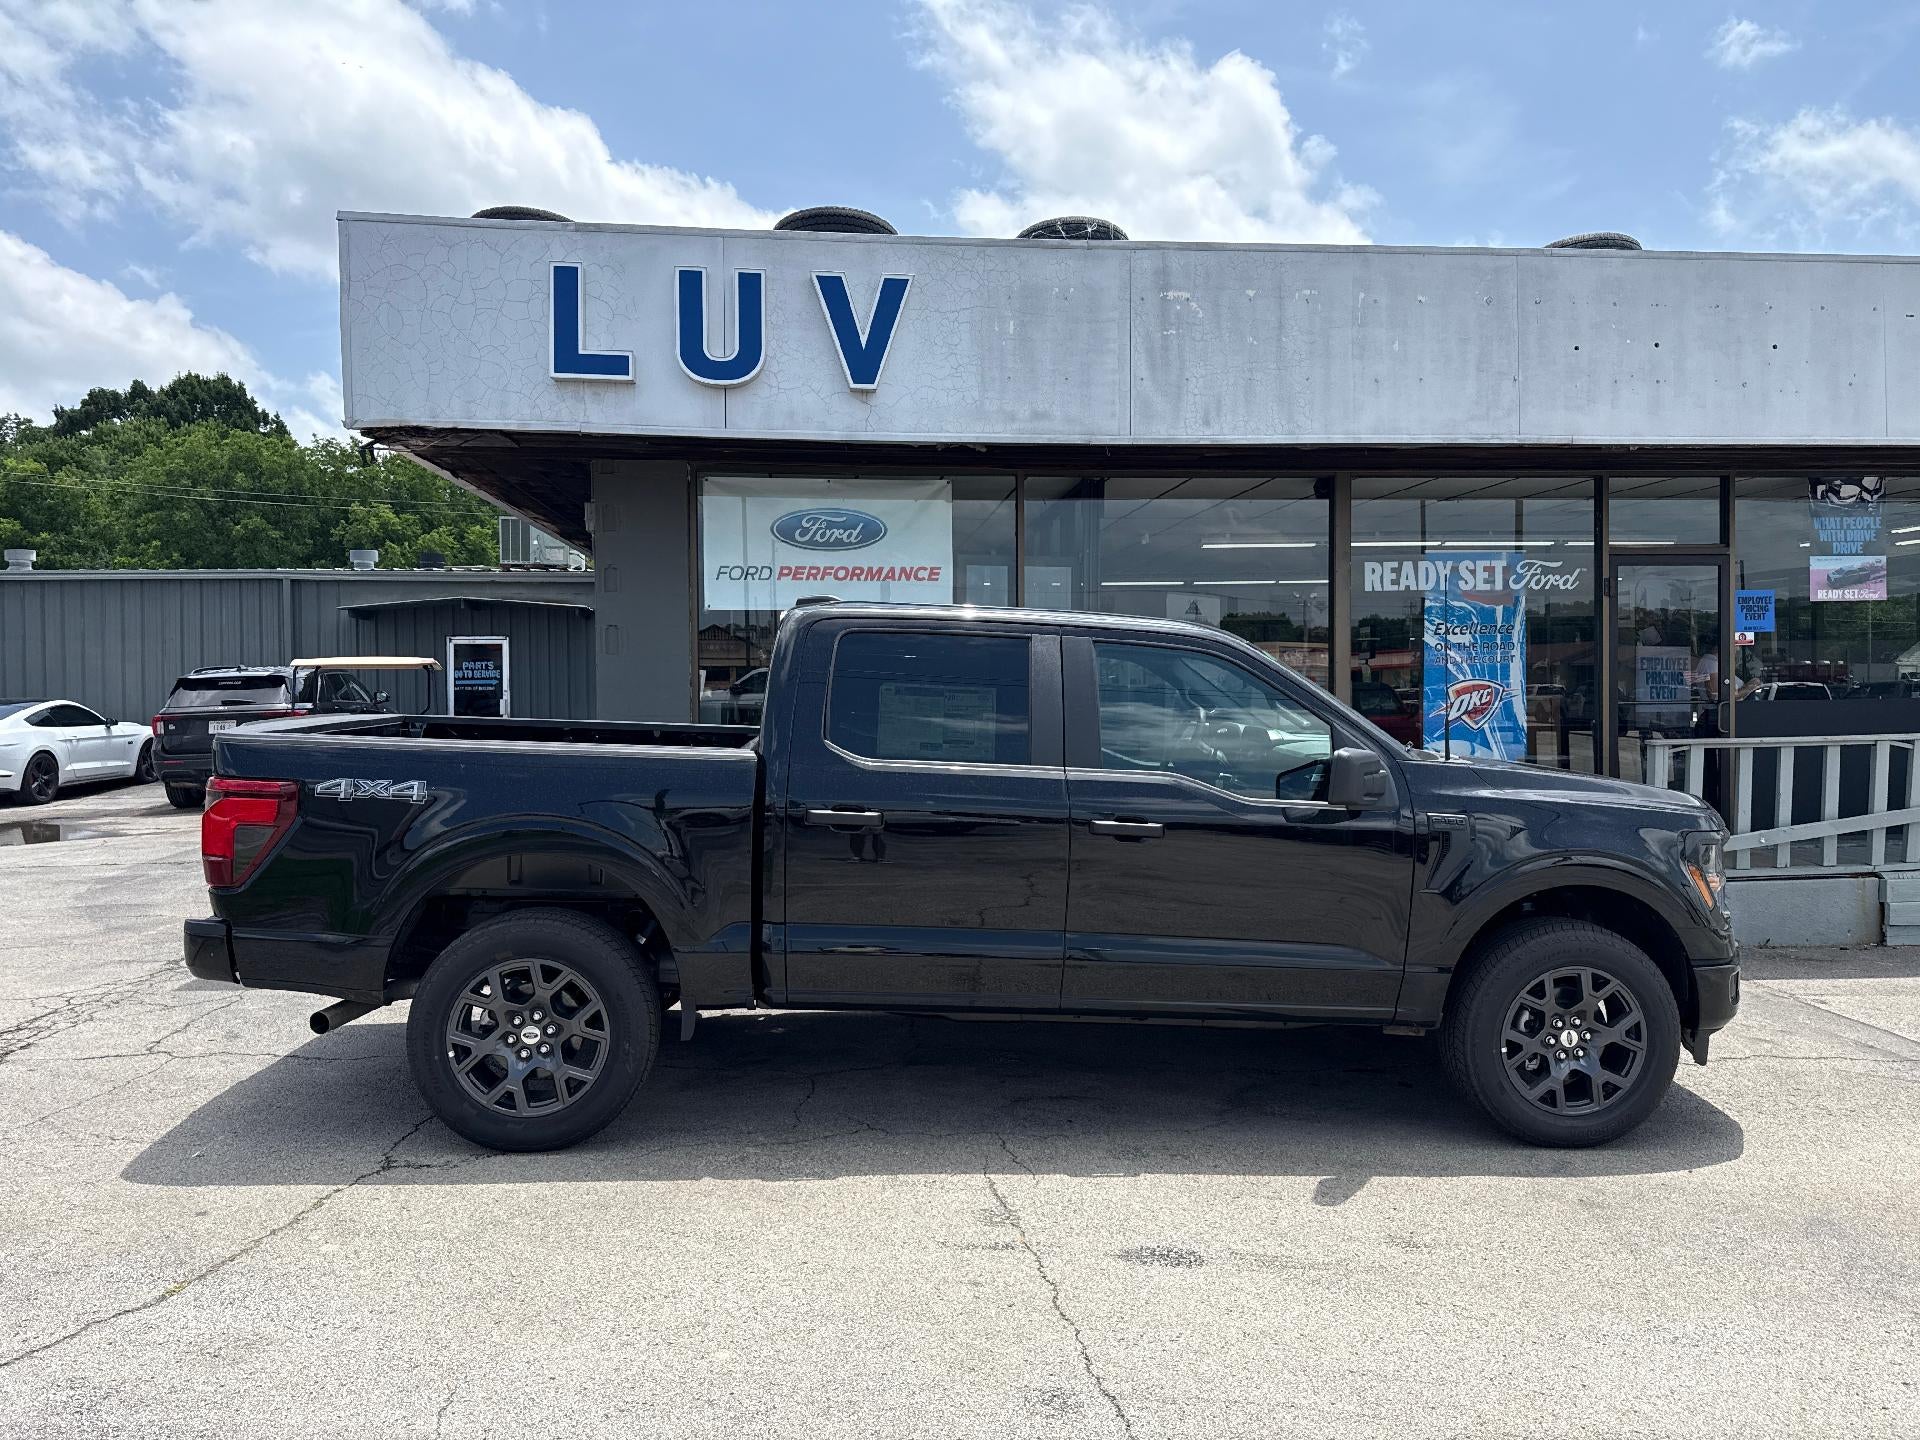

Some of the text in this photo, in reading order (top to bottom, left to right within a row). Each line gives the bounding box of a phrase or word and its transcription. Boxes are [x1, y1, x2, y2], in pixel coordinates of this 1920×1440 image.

[549, 261, 914, 391] LUV
[794, 514, 864, 543] Ford
[1813, 516, 1881, 529] WHAT PEOPLE
[1819, 529, 1877, 541] WITH DRIVE
[1832, 541, 1864, 554] DRIVE
[715, 565, 941, 582] FORD PERFORMANCE
[1364, 561, 1453, 591] READY
[1458, 560, 1507, 591] SET
[1737, 596, 1772, 605] EMPLOYEE
[1817, 588, 1881, 600] READY SET Ford
[1740, 604, 1769, 613] PRICING
[1744, 612, 1766, 621] EVENT
[1433, 621, 1515, 636] Excellence
[1434, 641, 1515, 653] ON THE ROAD
[462, 661, 494, 670] PARTS
[1434, 655, 1515, 665] AND THE COURT
[1640, 656, 1689, 671] EMPLOYEE
[464, 670, 473, 679] TO
[473, 670, 501, 679] SERVICE
[1645, 671, 1684, 686] PRICING
[1649, 686, 1678, 700] EVENT
[1448, 688, 1493, 720] OKC
